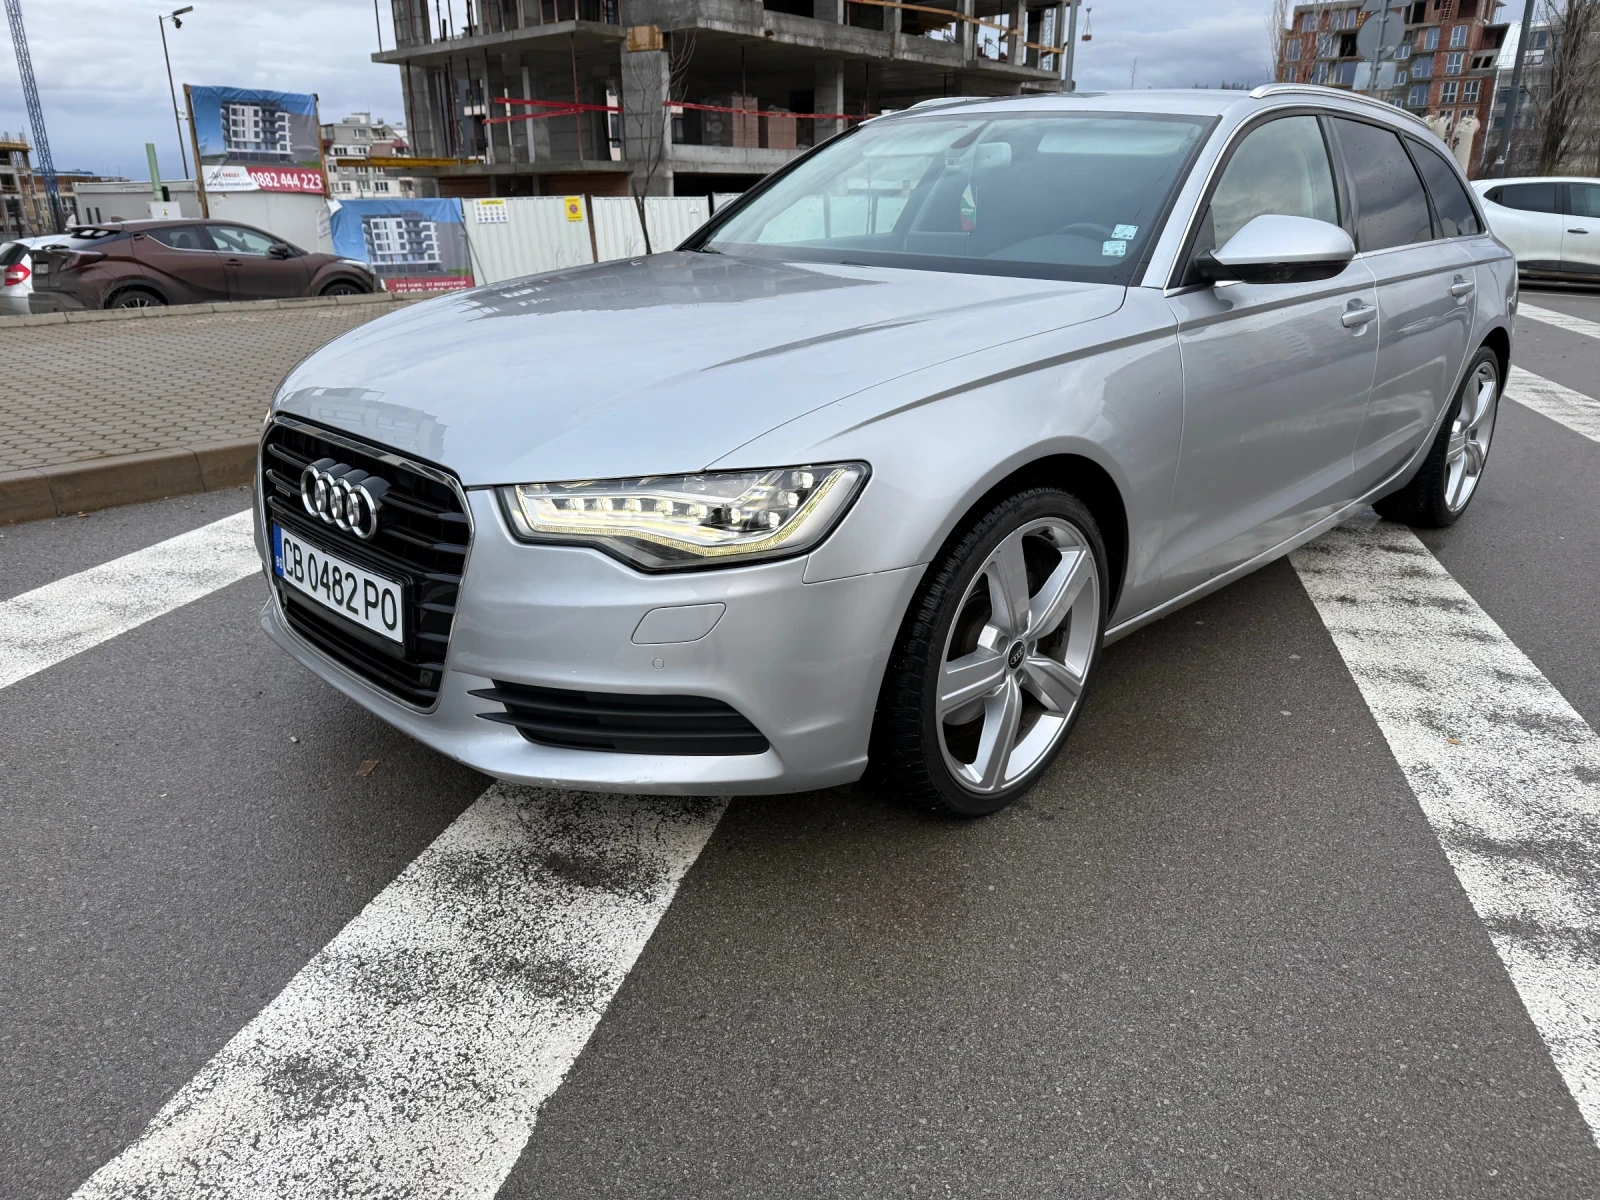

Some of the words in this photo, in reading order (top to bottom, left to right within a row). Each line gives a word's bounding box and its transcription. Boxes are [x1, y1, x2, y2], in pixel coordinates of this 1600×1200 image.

[251, 172, 280, 187] 0882
[281, 173, 300, 187] 444
[301, 174, 322, 189] 223
[284, 538, 304, 583] CB
[308, 553, 359, 615] 0482
